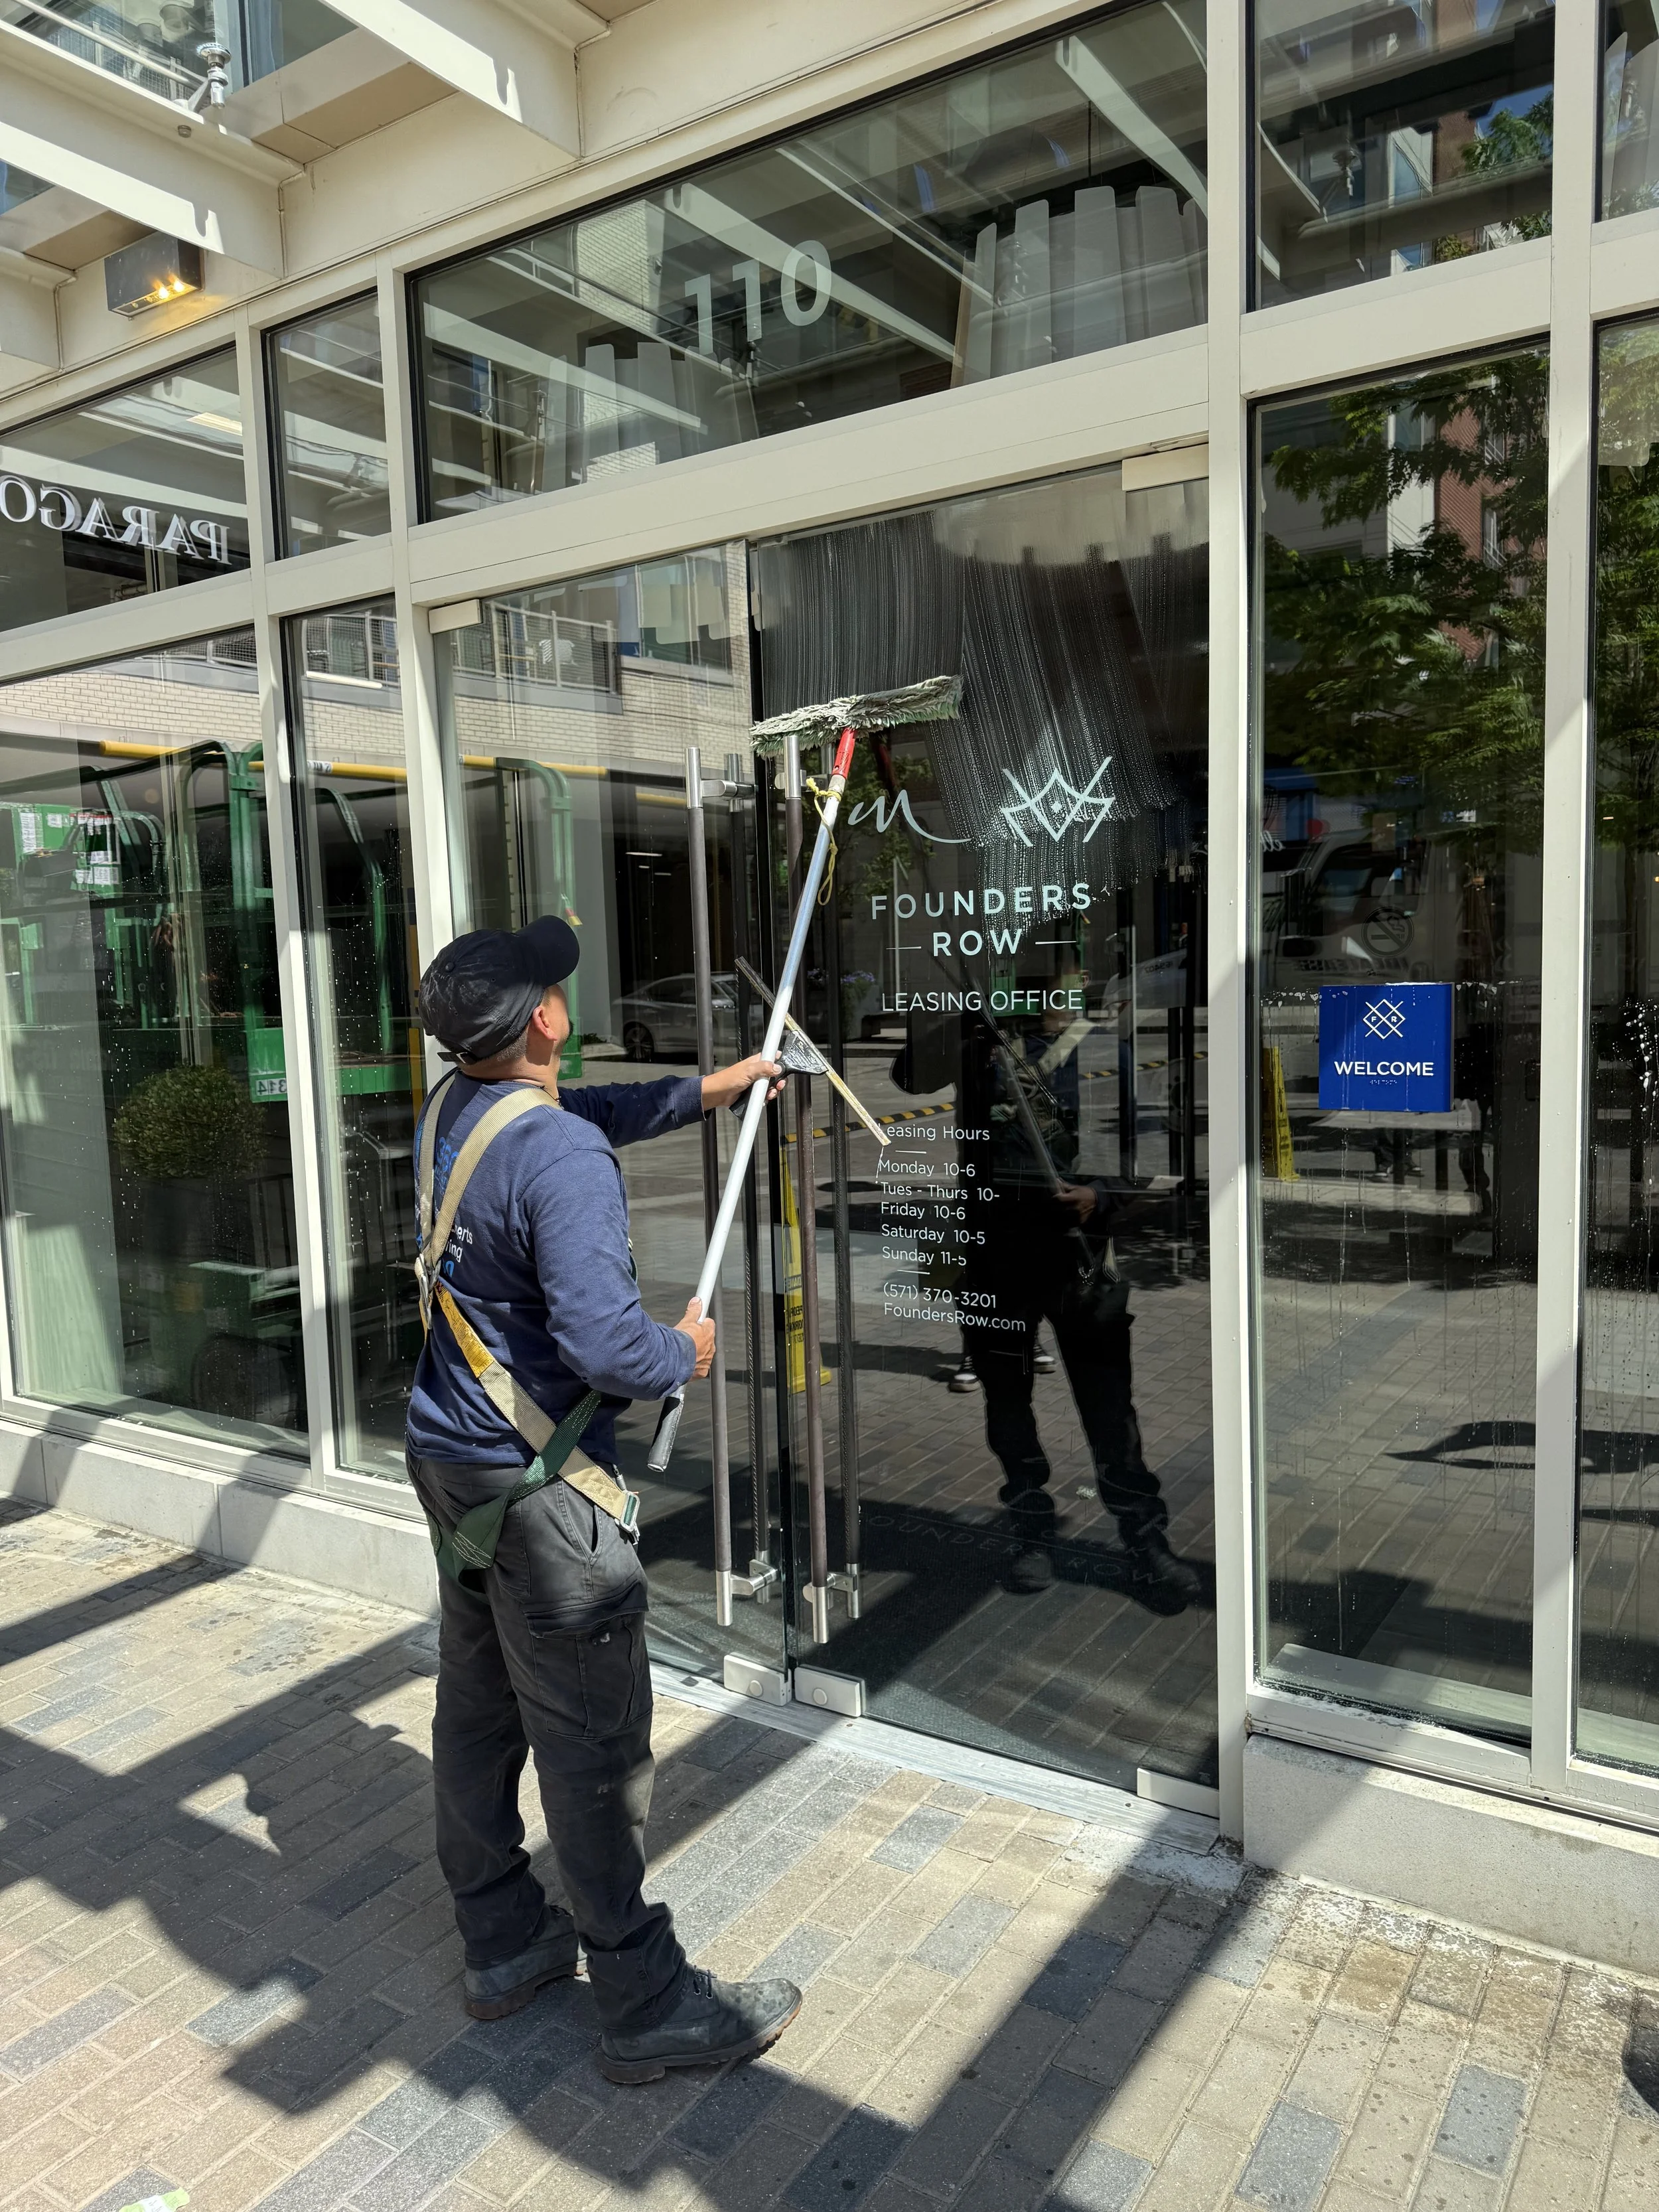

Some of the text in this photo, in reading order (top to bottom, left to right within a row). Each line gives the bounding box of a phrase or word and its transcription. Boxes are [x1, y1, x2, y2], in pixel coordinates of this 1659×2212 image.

[684, 240, 832, 356] 110
[871, 882, 1092, 920] FOUNDERS
[932, 928, 1023, 957] ROW
[882, 989, 1083, 1012] LEASING OFFICE
[1334, 1061, 1434, 1076] WELCOME
[879, 1123, 991, 1142] easing Hours
[879, 1159, 976, 1177] Monday 10-6
[881, 1181, 912, 1196] Tues
[928, 1185, 968, 1200] Thurs
[881, 1201, 966, 1220] Friday 10-6
[881, 1224, 986, 1245] Saturday 10-5
[882, 1246, 967, 1266] Sunday 11-5
[883, 1281, 997, 1309] (571) 370-3201
[884, 1302, 1026, 1332] FoundersRow.com
[868, 1515, 1043, 1560] OUNDERS
